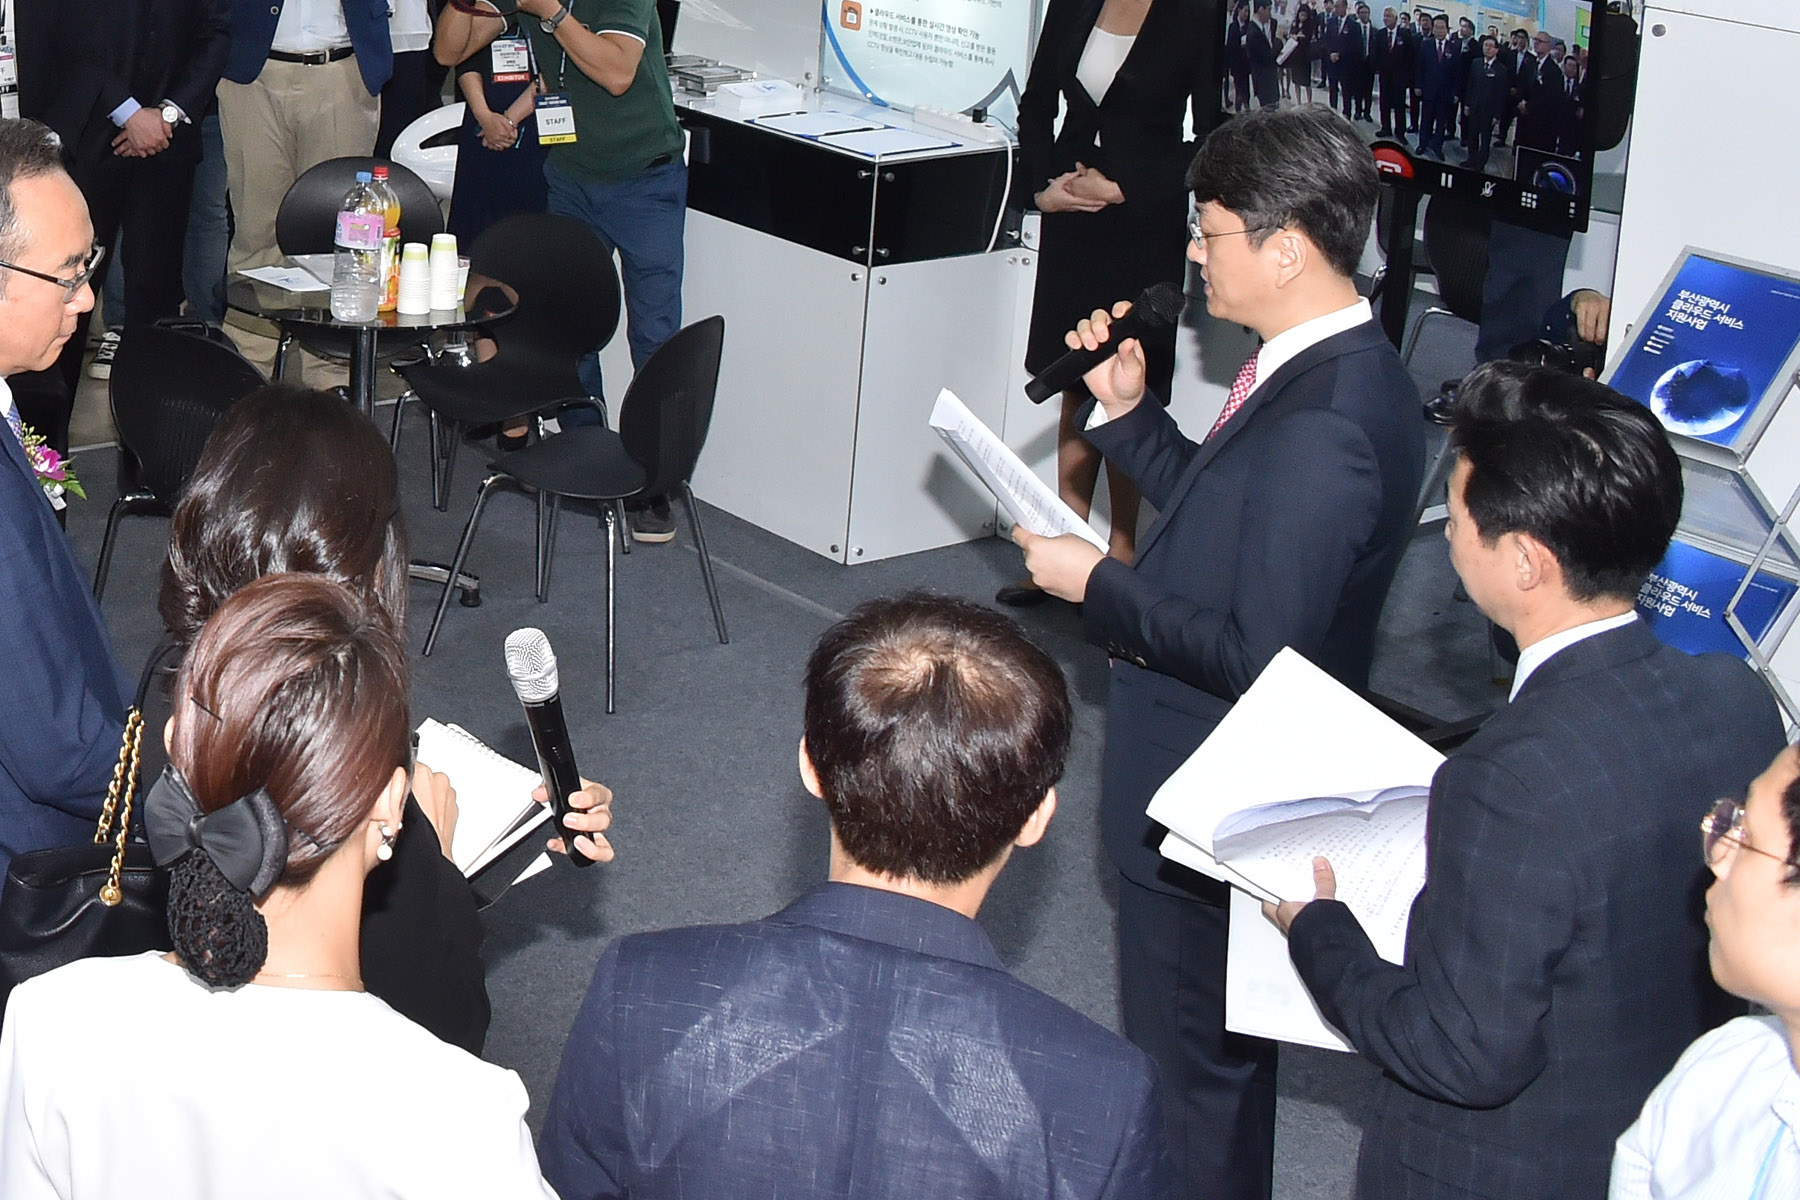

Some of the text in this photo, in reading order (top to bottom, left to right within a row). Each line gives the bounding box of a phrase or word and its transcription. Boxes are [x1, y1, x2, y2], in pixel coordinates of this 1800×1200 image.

[545, 117, 566, 125] STAFF
[1671, 299, 1745, 330] 클라우드 서비스
[1677, 289, 1731, 314] 부산광역시
[1665, 308, 1709, 331] 지원사업
[1647, 573, 1699, 601] 부산광역시
[1636, 592, 1677, 618] 지원사업
[1640, 582, 1712, 619] 클라우드 서비스
